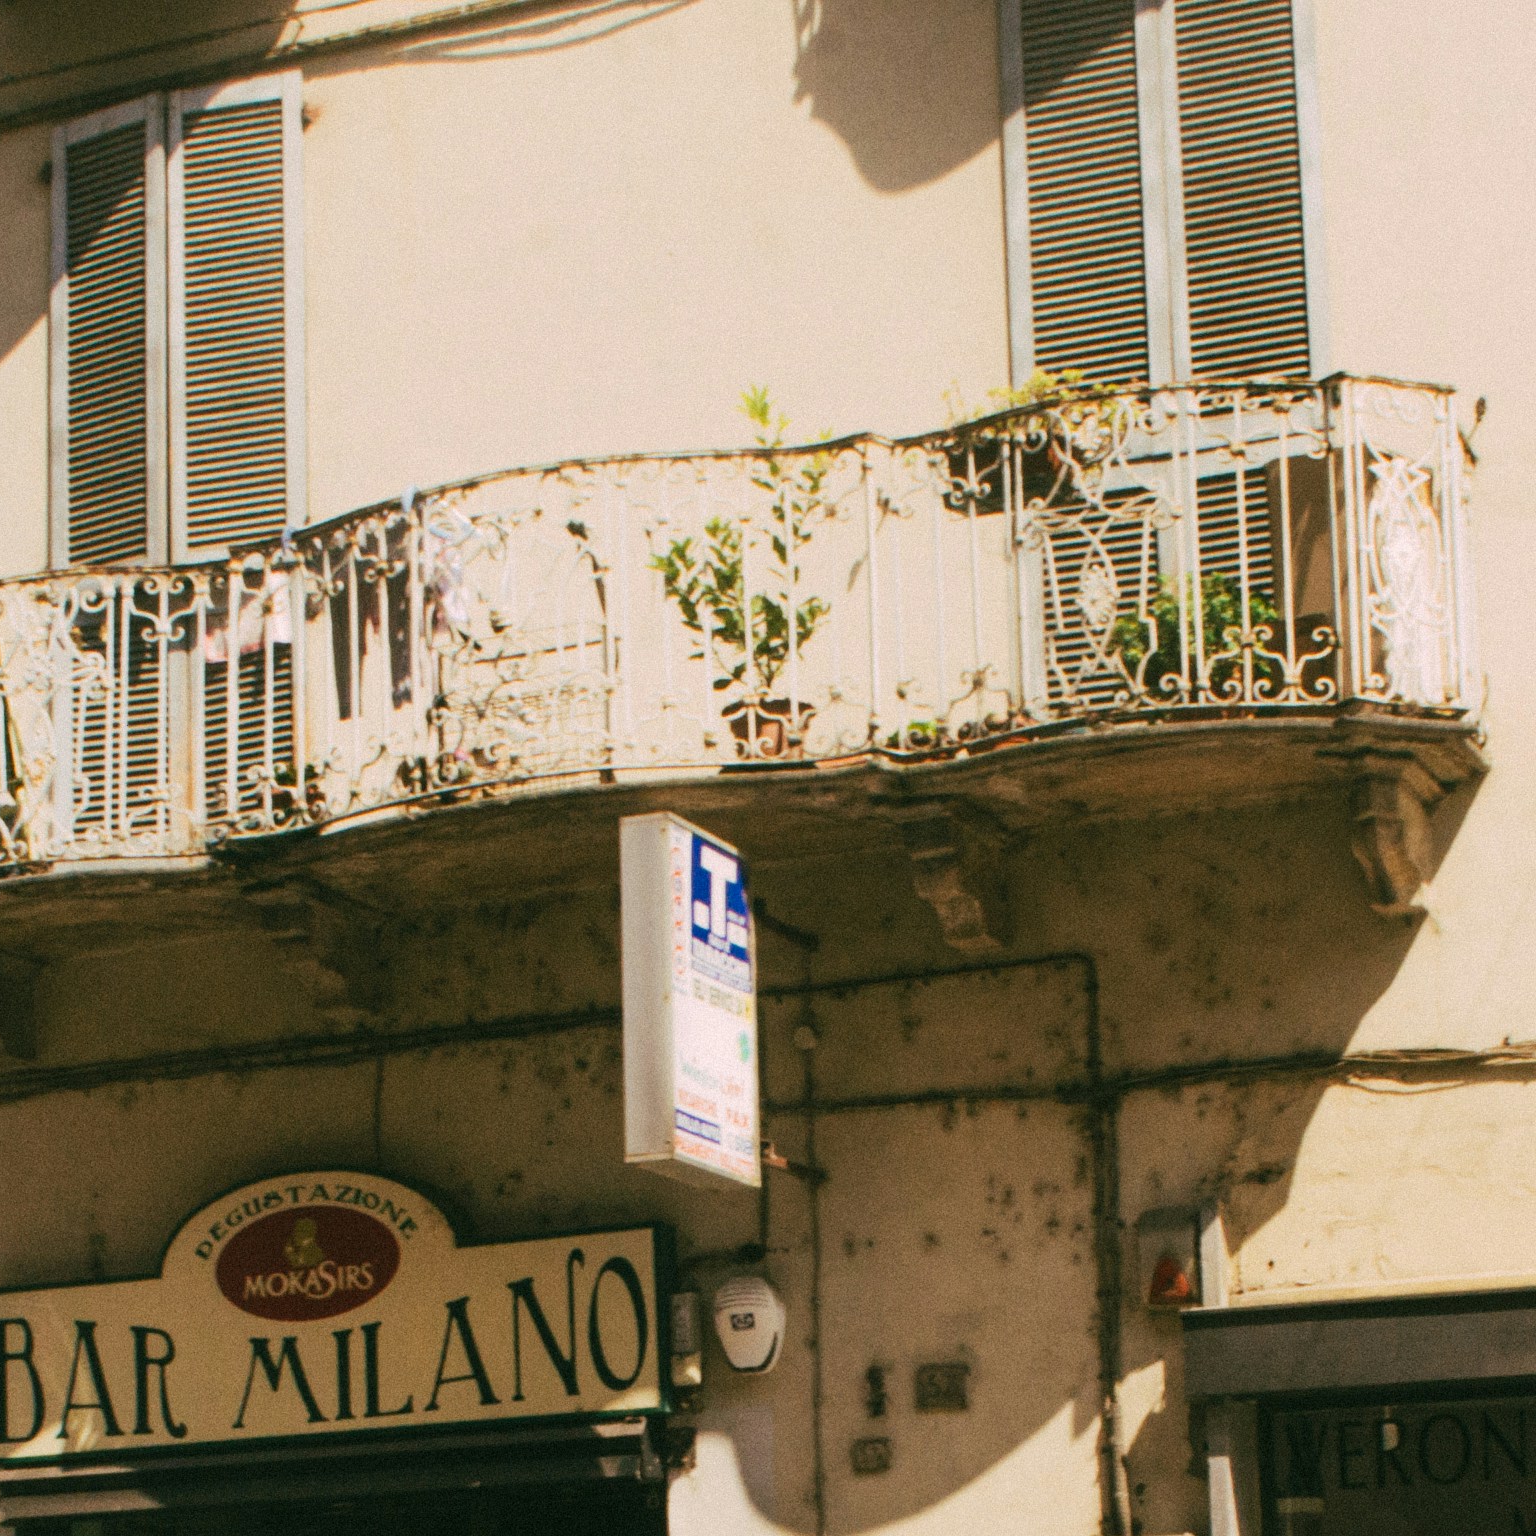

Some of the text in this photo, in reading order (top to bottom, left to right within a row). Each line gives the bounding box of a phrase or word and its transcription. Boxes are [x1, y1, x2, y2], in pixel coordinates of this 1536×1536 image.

[700, 845, 738, 939] T
[195, 1184, 418, 1260] DEGUSTAZIONE
[232, 1249, 649, 1430] MILANO
